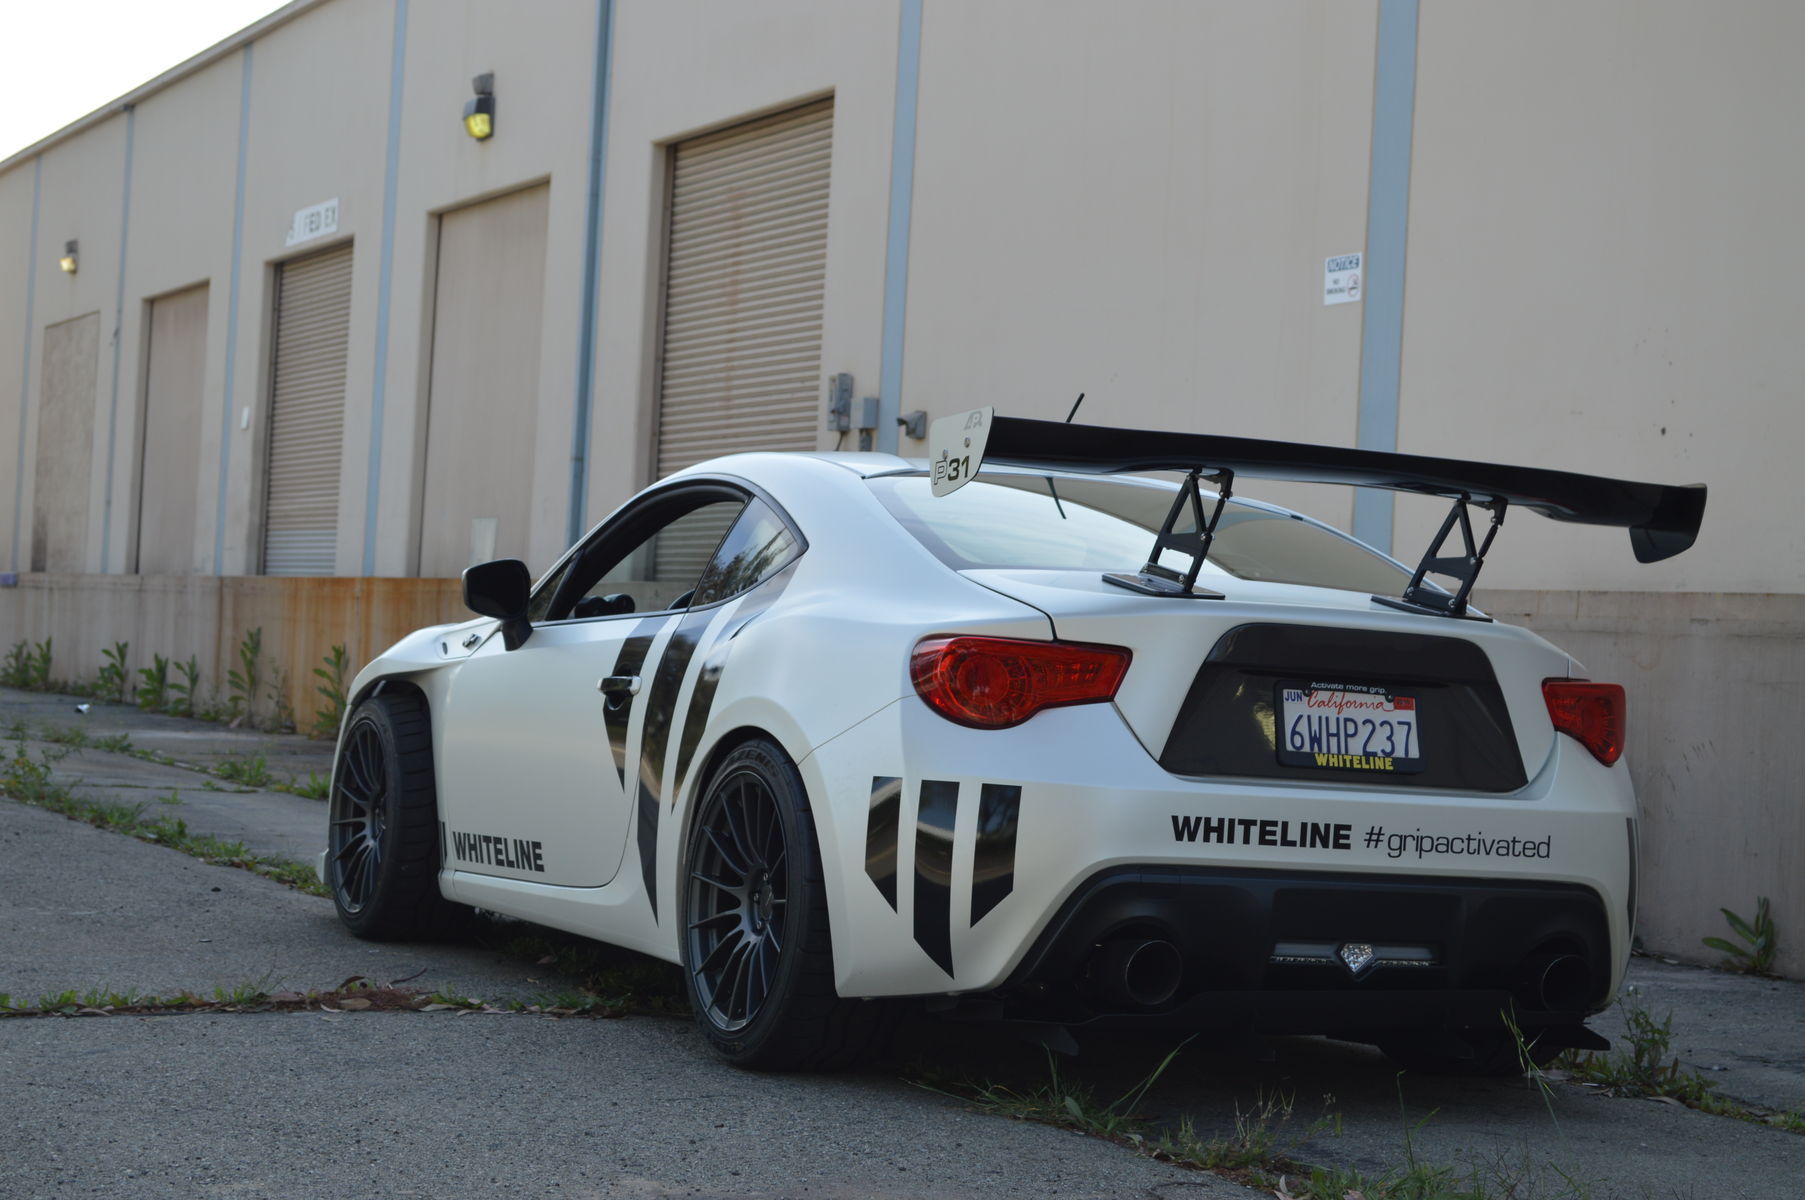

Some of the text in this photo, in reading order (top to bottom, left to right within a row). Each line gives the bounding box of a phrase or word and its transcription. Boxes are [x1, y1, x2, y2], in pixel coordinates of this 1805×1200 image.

[933, 455, 970, 486] P31
[1284, 691, 1303, 702] JUN
[1310, 681, 1344, 690] Activate
[1345, 684, 1368, 692] more
[1306, 690, 1395, 715] California
[1290, 714, 1412, 758] 6WHP237
[1314, 753, 1394, 771] WHITELINE
[452, 831, 545, 872] WHITELINE
[1171, 815, 1551, 860] WHITELINE #gripactivated
